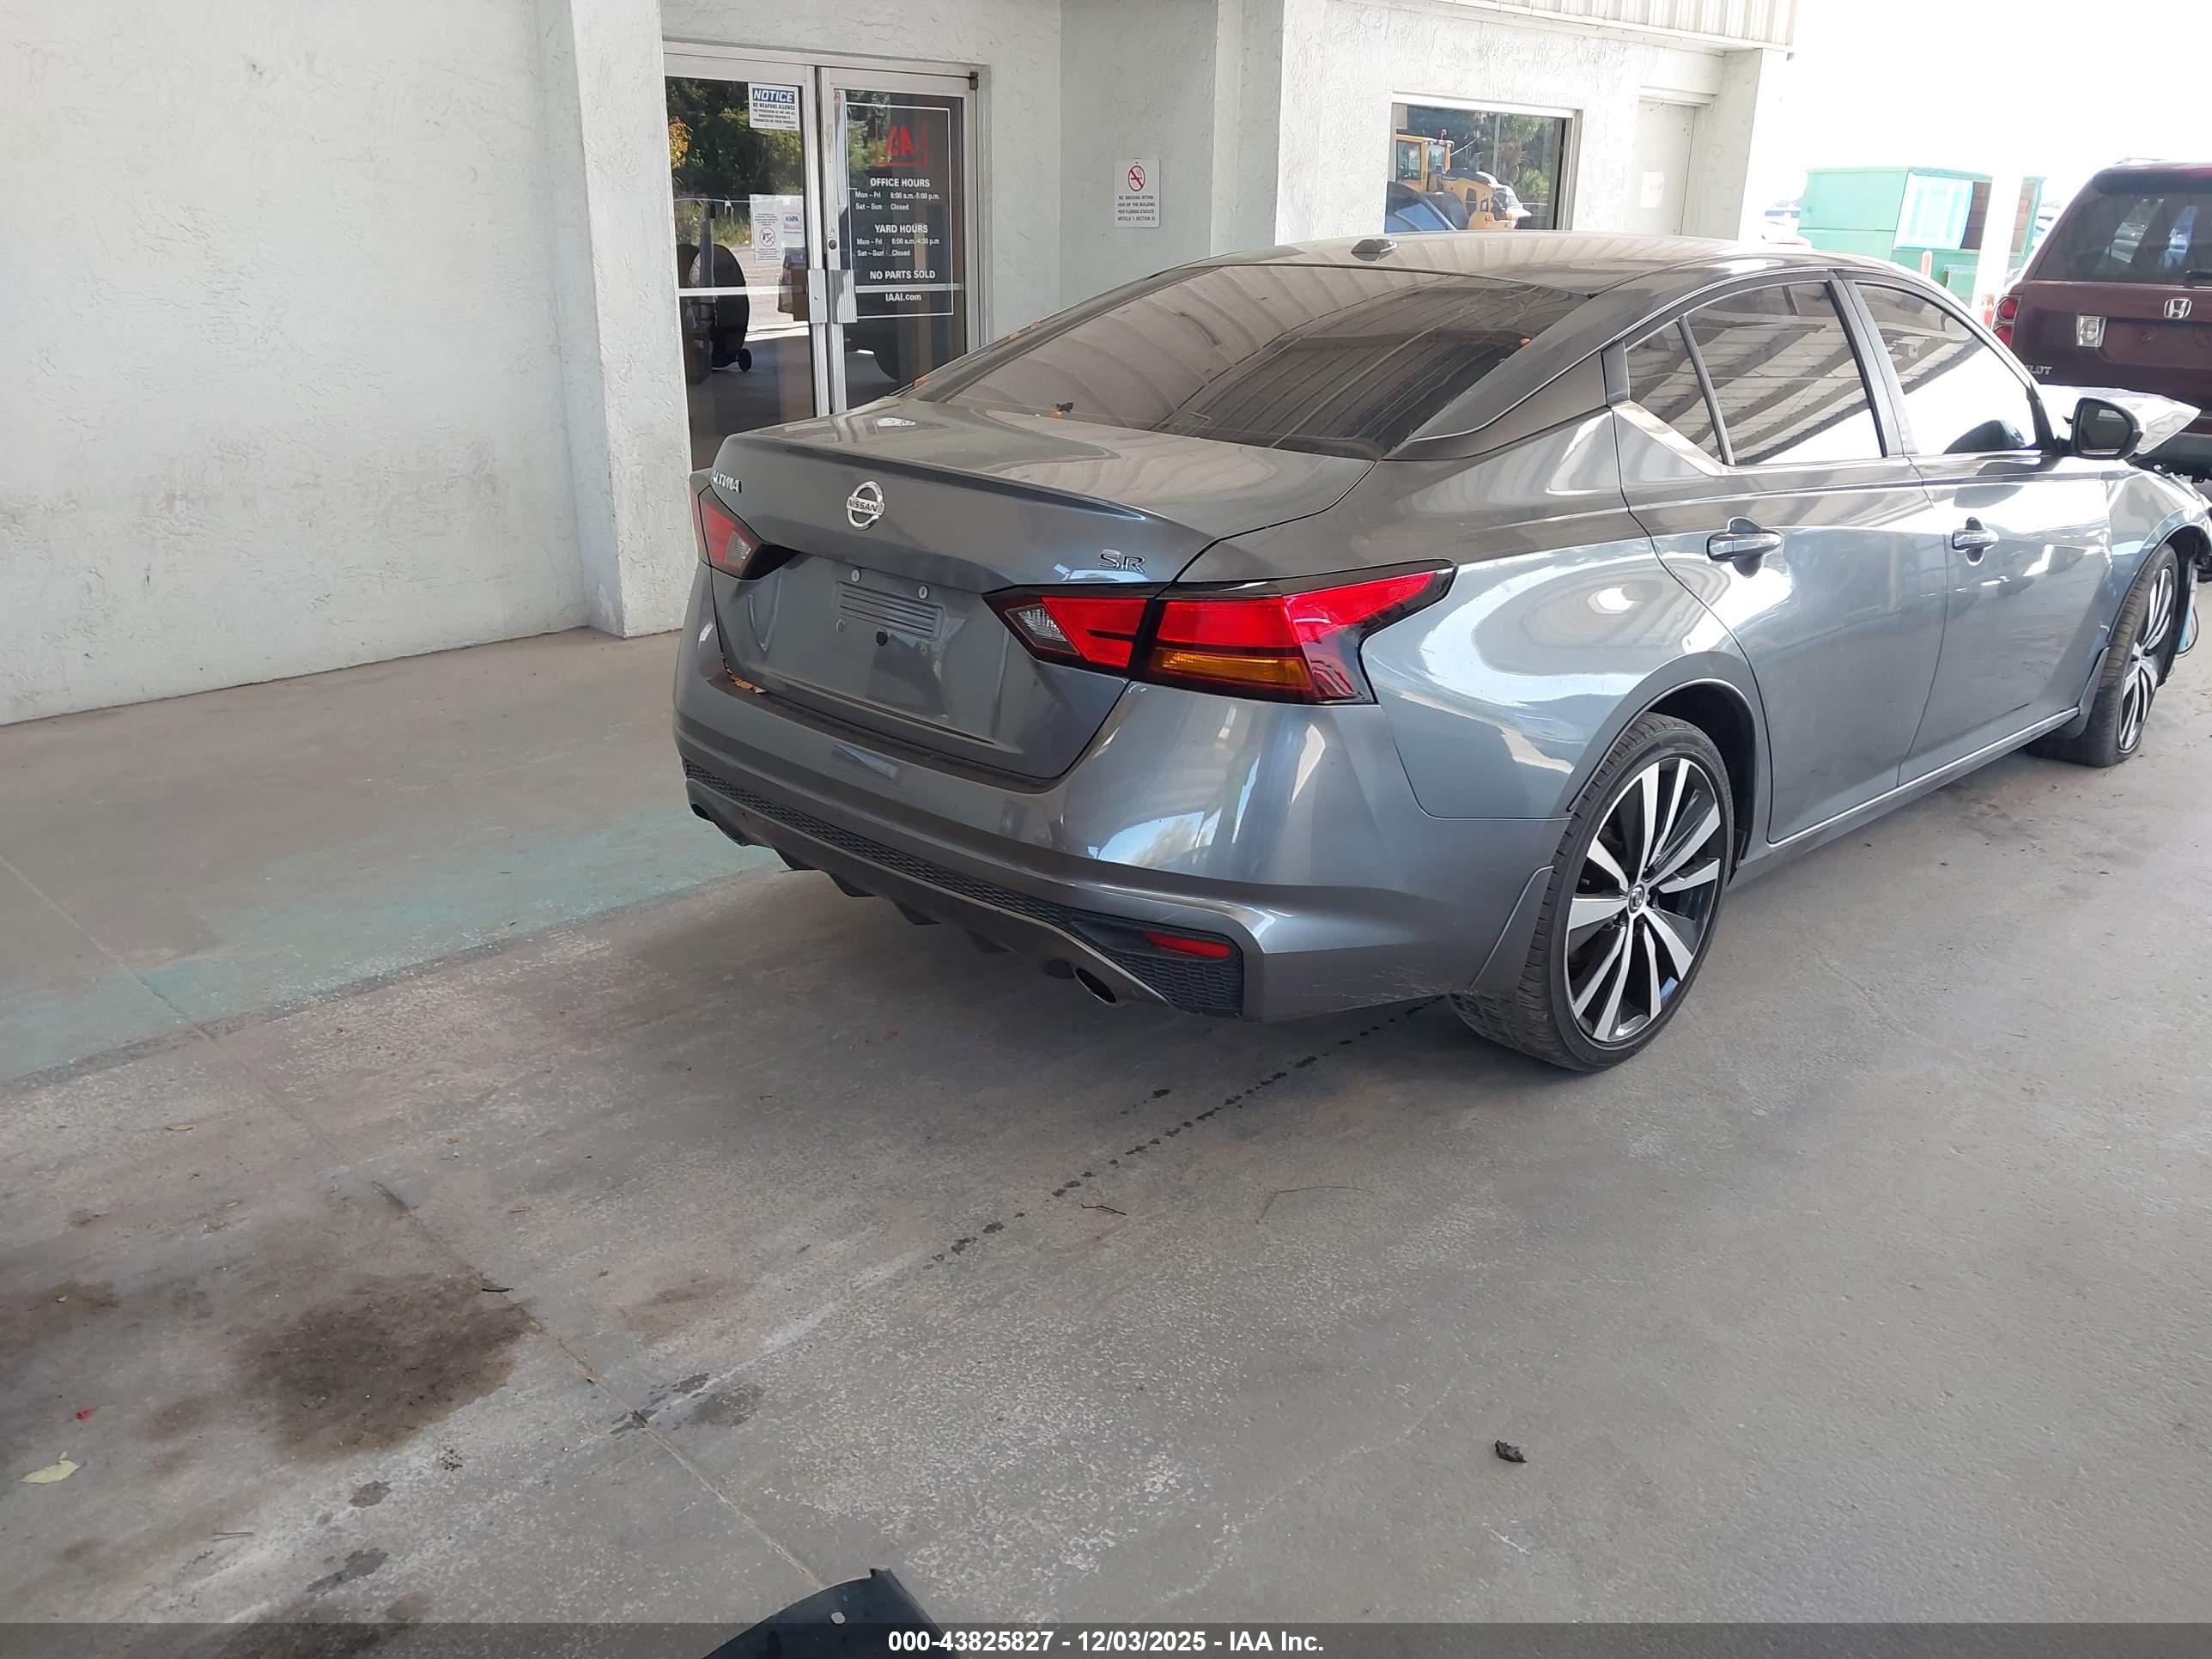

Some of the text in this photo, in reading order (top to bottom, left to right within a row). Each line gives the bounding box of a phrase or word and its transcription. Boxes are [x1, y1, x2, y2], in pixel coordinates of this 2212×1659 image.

[754, 89, 794, 103] NOTICE
[870, 178, 931, 188] OFFICE HOURS
[874, 224, 928, 234] YARD HOURS
[870, 270, 936, 280] NO PARTS SOLD
[885, 293, 921, 302] IAAI.com
[849, 498, 878, 513] NISSAN
[1098, 550, 1146, 574] SR
